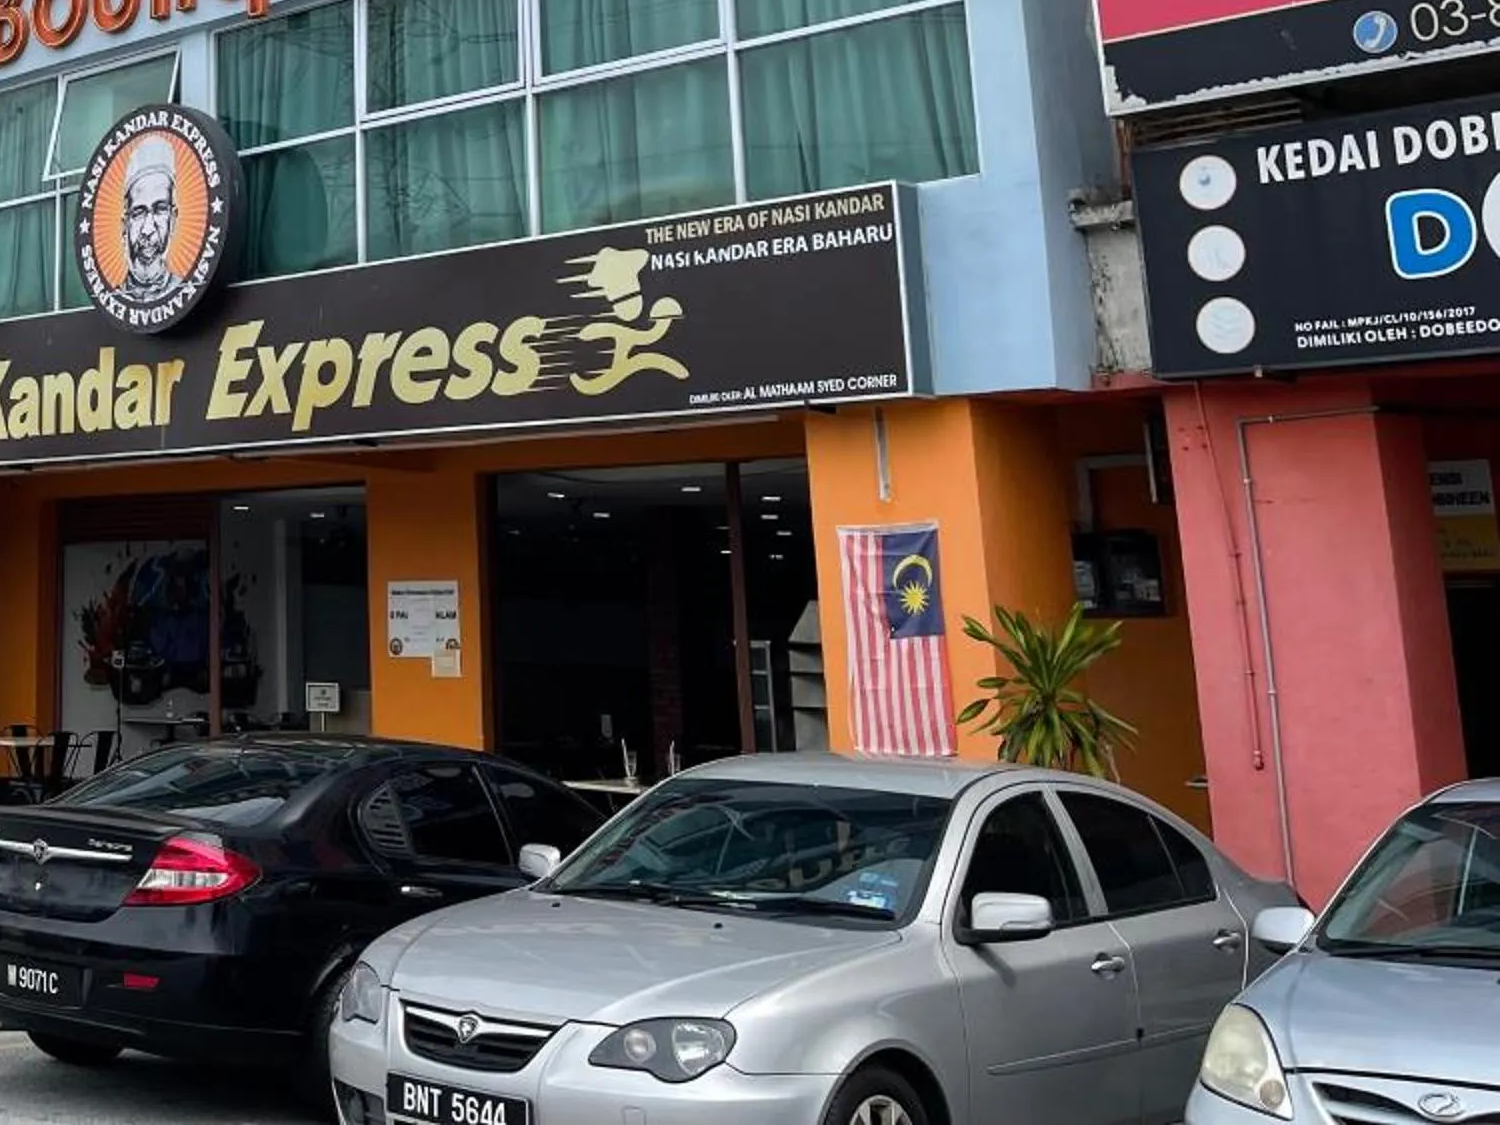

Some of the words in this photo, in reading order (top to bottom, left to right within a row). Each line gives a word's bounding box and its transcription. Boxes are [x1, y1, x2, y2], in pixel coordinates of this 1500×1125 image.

[81, 156, 107, 210] NASI
[103, 110, 168, 157] KANDAR
[170, 113, 221, 189] EXPRESS
[1257, 130, 1381, 185] KEDAI
[645, 225, 674, 245] THE
[676, 219, 711, 241] NEW
[713, 215, 745, 235] ERA
[747, 210, 768, 230] OF
[771, 204, 810, 226] NASI
[815, 192, 885, 221] KANDAR
[650, 250, 690, 272] NASI
[694, 240, 769, 265] KANDAR
[772, 235, 808, 257] ERA
[813, 222, 893, 252] BAHARU
[1295, 322, 1313, 332] NO
[1315, 319, 1340, 330] FAIL
[1297, 331, 1362, 349] DIMILIKI
[1364, 328, 1408, 343] OLEH
[205, 316, 547, 433] Express
[743, 386, 756, 400] AL
[759, 380, 815, 398] MATHAAM
[817, 377, 845, 394] SYED
[846, 373, 897, 390] CORNER
[402, 1082, 443, 1119] BNT
[451, 1091, 507, 1125] 5644
